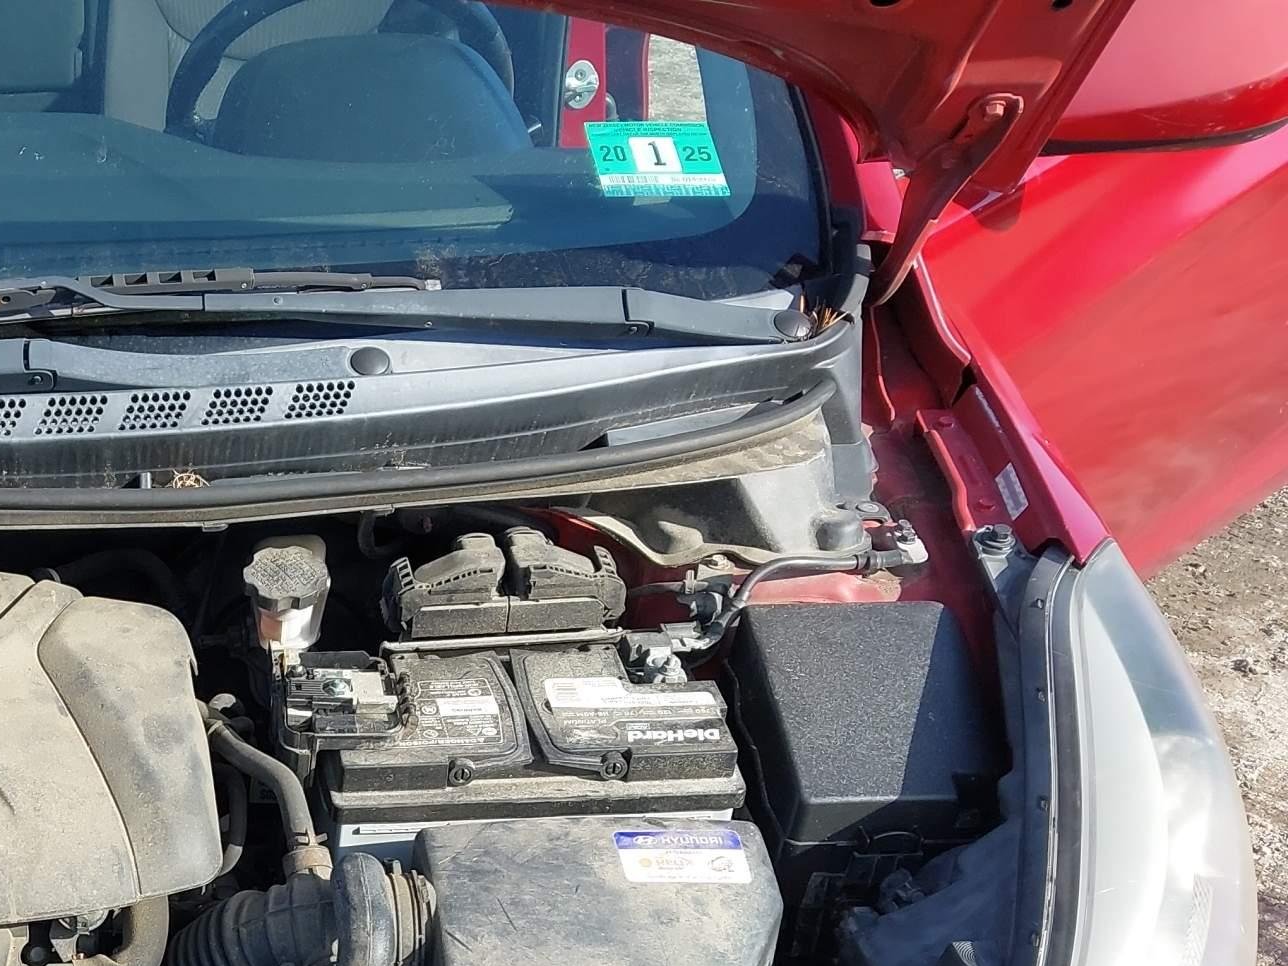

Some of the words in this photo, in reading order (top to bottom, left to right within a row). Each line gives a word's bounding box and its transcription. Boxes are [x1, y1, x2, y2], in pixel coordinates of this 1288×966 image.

[599, 145, 627, 162] 20
[647, 140, 667, 166] 1
[682, 145, 712, 162] 25
[627, 727, 721, 743] DieHard
[661, 835, 723, 845] HYUNDAI
